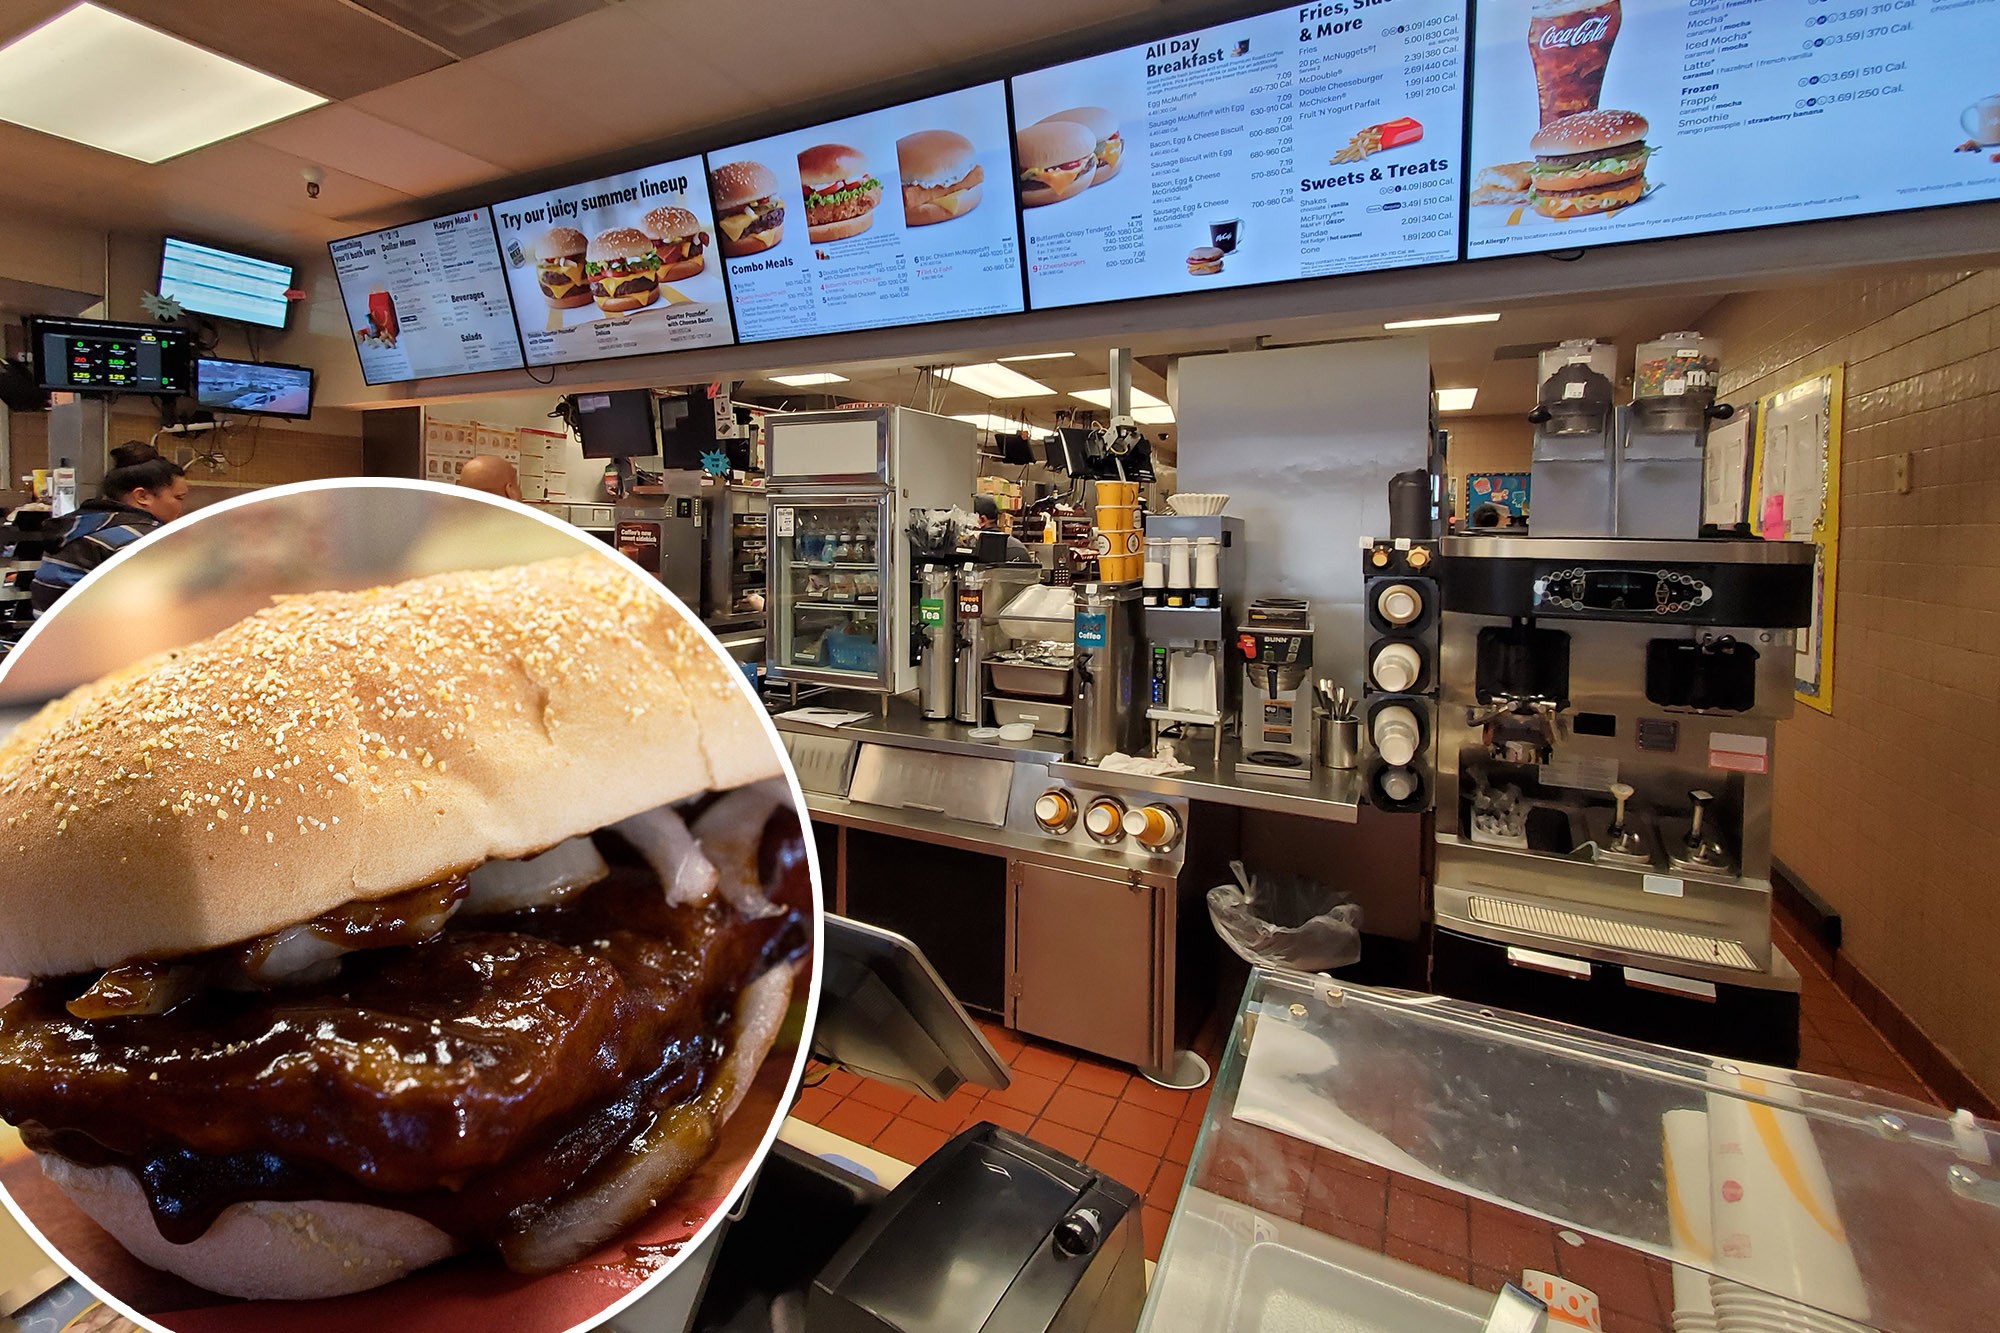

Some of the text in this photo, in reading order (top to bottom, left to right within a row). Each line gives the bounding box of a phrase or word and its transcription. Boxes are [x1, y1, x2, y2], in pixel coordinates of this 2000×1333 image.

[1299, 2, 1348, 23] Fries,
[1871, 3, 1892, 14] 310
[1443, 14, 1459, 23] Cal.
[1300, 18, 1363, 42] & More
[1724, 21, 1751, 30] mocha
[1866, 22, 1913, 38] 370 Cal.
[1442, 26, 1458, 36] Cal.
[1686, 37, 1708, 50] Iced
[1722, 43, 1748, 52] mocha
[1146, 38, 1200, 60] All Day
[1298, 46, 1318, 55] Fries
[1442, 44, 1458, 54] Cal.
[1147, 48, 1224, 77] Breakfast
[1298, 58, 1321, 68] 20 pc.
[1442, 58, 1458, 67] Cal.
[1682, 52, 1812, 80] caramel hazelnut french vanilla
[1863, 62, 1907, 76] 510 Cal.
[1277, 72, 1292, 80] 7.09
[1442, 72, 1458, 80] Cal.
[1249, 84, 1278, 94] 450-730
[1300, 74, 1384, 97] Double Cheeseburger
[1426, 84, 1457, 96] 210 Cal.
[1682, 84, 1719, 95] Frozen
[1882, 84, 1904, 95] Cal.
[1277, 94, 1292, 102] 7.09
[1680, 94, 1717, 107] Frappé
[1250, 106, 1279, 116] 630-910
[1300, 98, 1380, 120] Fruit Yogurt Parfait
[1680, 100, 1742, 116] caramel mocha
[1149, 118, 1176, 129] Sausage
[1215, 107, 1230, 116] with
[1277, 116, 1292, 124] 7.09
[1677, 108, 1824, 136] mango pineapple strawberry banana
[1678, 114, 1729, 128] Smoothie
[1173, 137, 1186, 145] Egg
[1194, 130, 1219, 140] Cheese
[1220, 125, 1244, 135] Biscuit
[1278, 138, 1292, 146] 7.09
[1250, 148, 1279, 158] 680-960
[1151, 158, 1178, 169] Sausage
[1180, 153, 1202, 163] Biscuit
[1219, 148, 1232, 156] Egg
[1280, 158, 1293, 166] 7.19
[1195, 172, 1220, 180] Cheese
[1251, 170, 1280, 180] 570-850
[1300, 159, 1448, 192] Sweets & Treats
[501, 176, 688, 230] Try our juicy summer lineup
[1252, 198, 1280, 208] 700-980
[1300, 198, 1327, 207] Shakes
[1439, 195, 1454, 203] Cal.
[1183, 204, 1196, 212] Egg
[1204, 198, 1228, 208] Cheese
[1438, 212, 1454, 220] Cal.
[433, 214, 470, 230] Happy Meal
[1066, 230, 1085, 238] Crispy
[1301, 230, 1328, 238] Sundae
[332, 240, 362, 252] Something
[381, 239, 416, 252] Dollar Menu
[1486, 237, 1510, 246] Allergy?
[336, 248, 376, 263] you'll both love
[732, 257, 794, 274] Combo Meals
[451, 291, 485, 303] Beverages
[460, 332, 482, 342] Salads
[960, 602, 978, 612] Tea
[922, 610, 940, 620] Tea
[1078, 632, 1101, 640] Coffee
